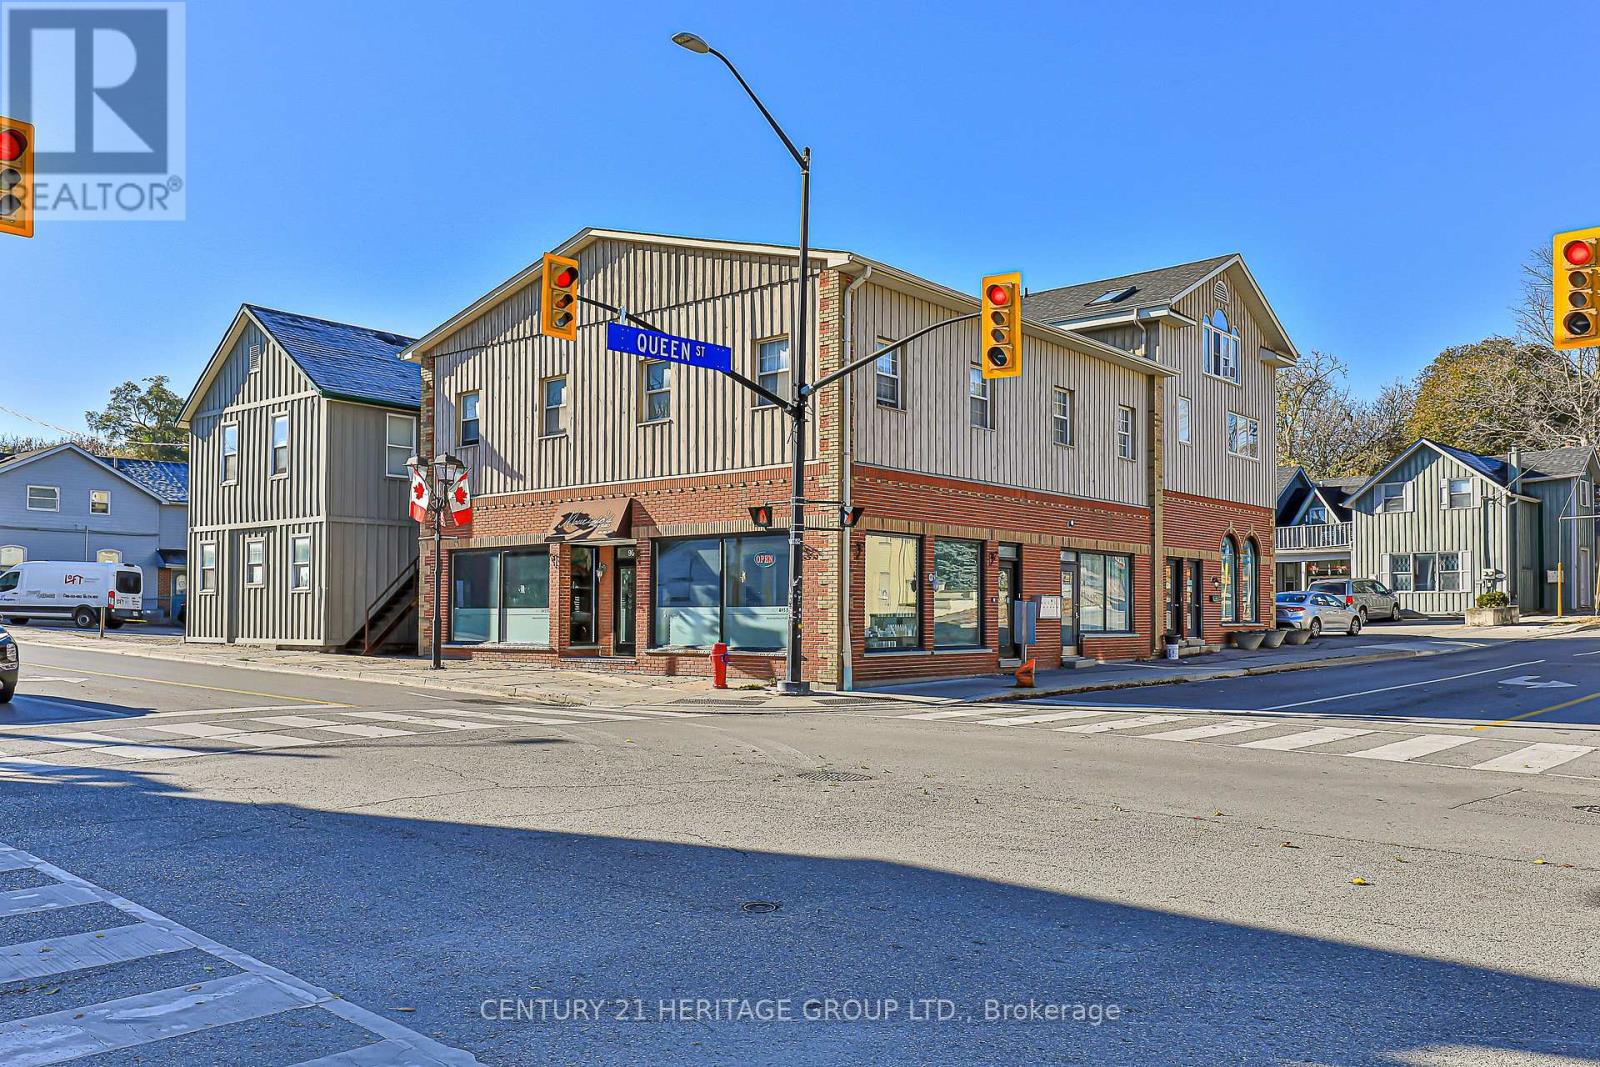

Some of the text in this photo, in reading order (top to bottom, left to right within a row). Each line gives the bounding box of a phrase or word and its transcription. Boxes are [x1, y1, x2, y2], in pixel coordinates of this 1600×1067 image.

[637, 333, 706, 362] QUEEN ST
[755, 554, 774, 564] OPEN
